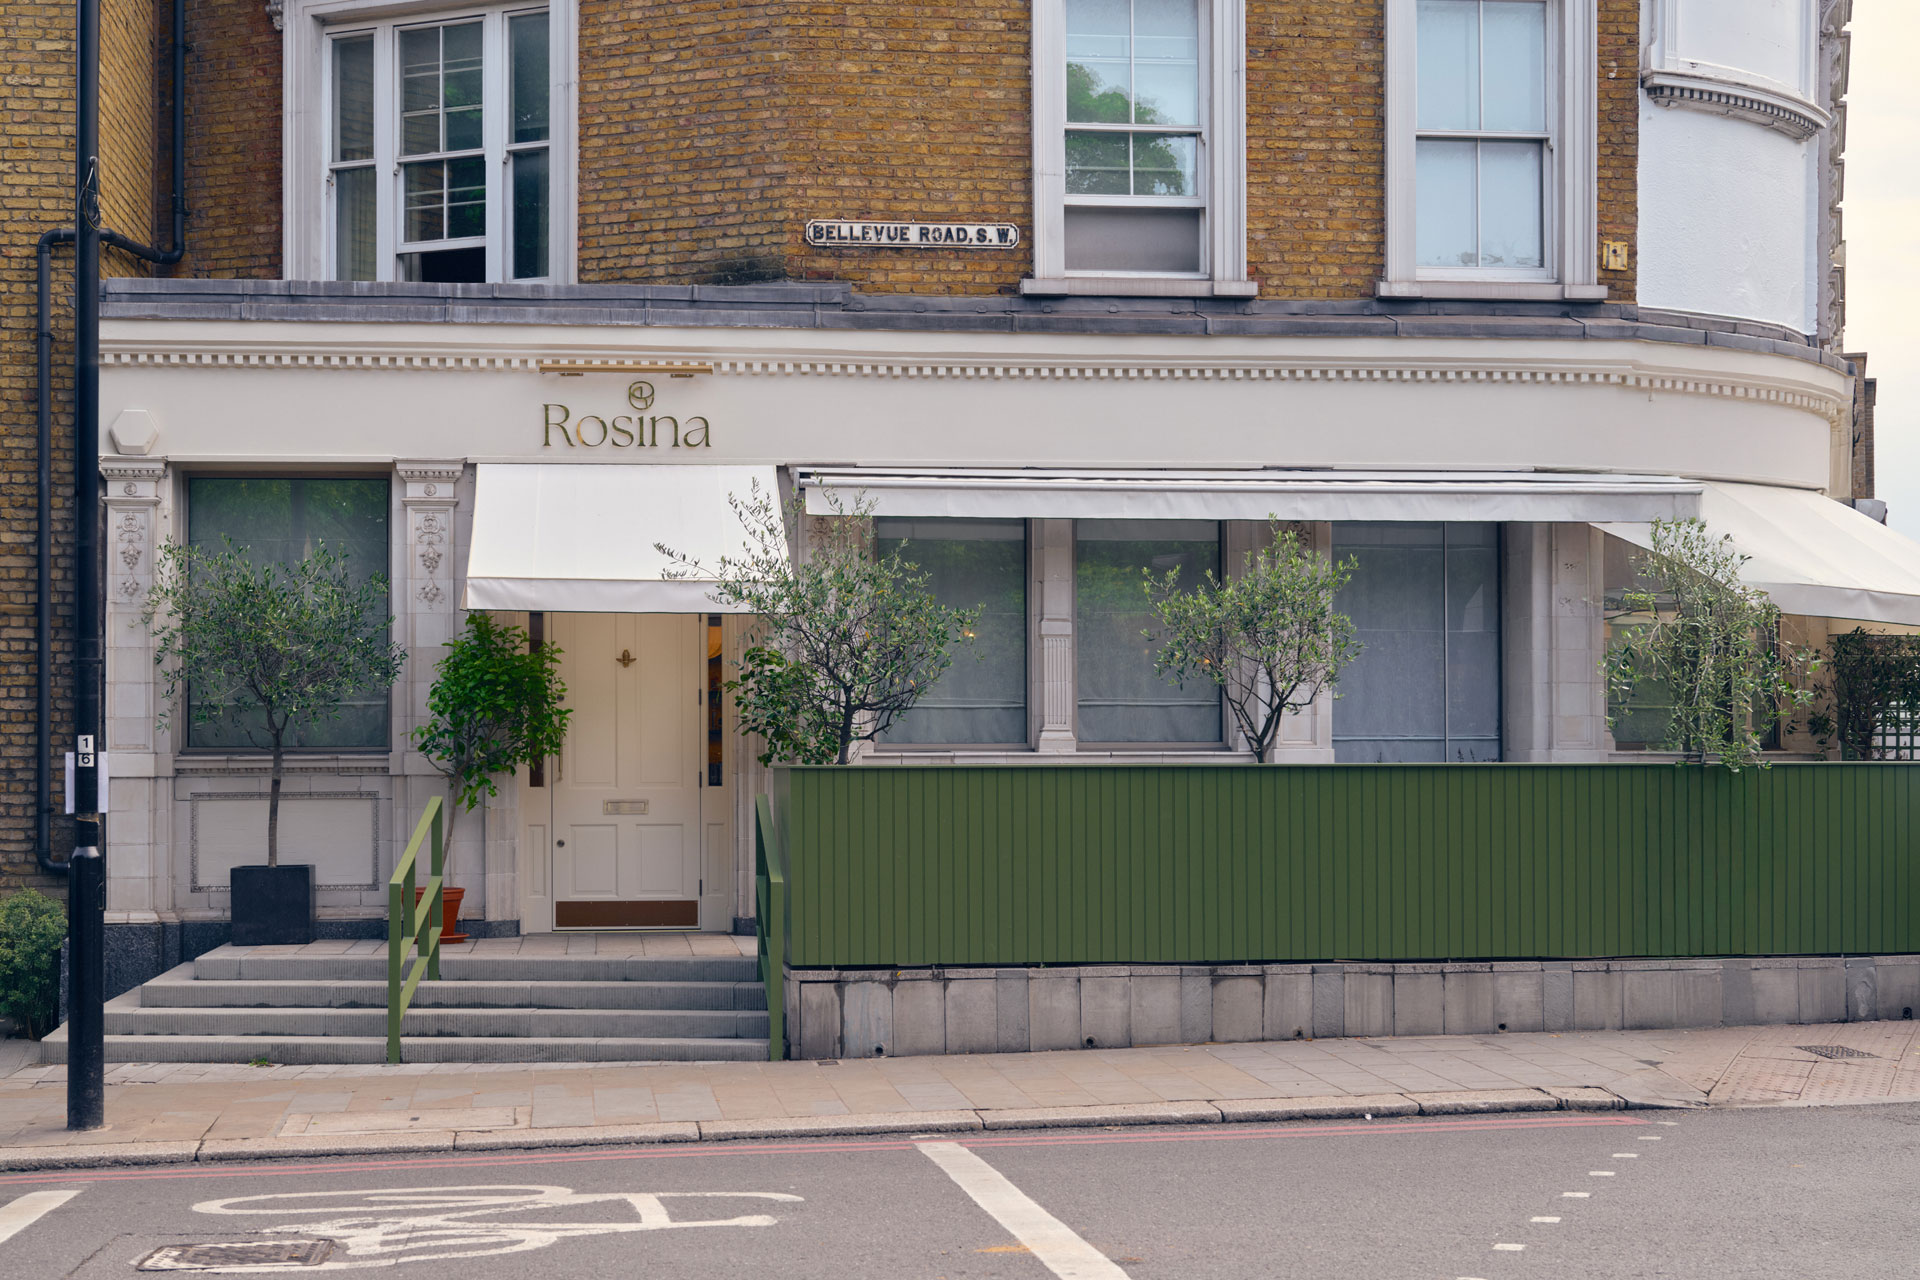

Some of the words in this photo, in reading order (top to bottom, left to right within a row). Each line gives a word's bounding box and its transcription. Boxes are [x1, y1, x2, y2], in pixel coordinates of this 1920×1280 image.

[813, 225, 910, 242] BELLEVUE
[920, 227, 973, 243] ROAD,
[543, 403, 711, 448] Rosina
[82, 737, 89, 749] 1
[81, 752, 91, 765] 6
